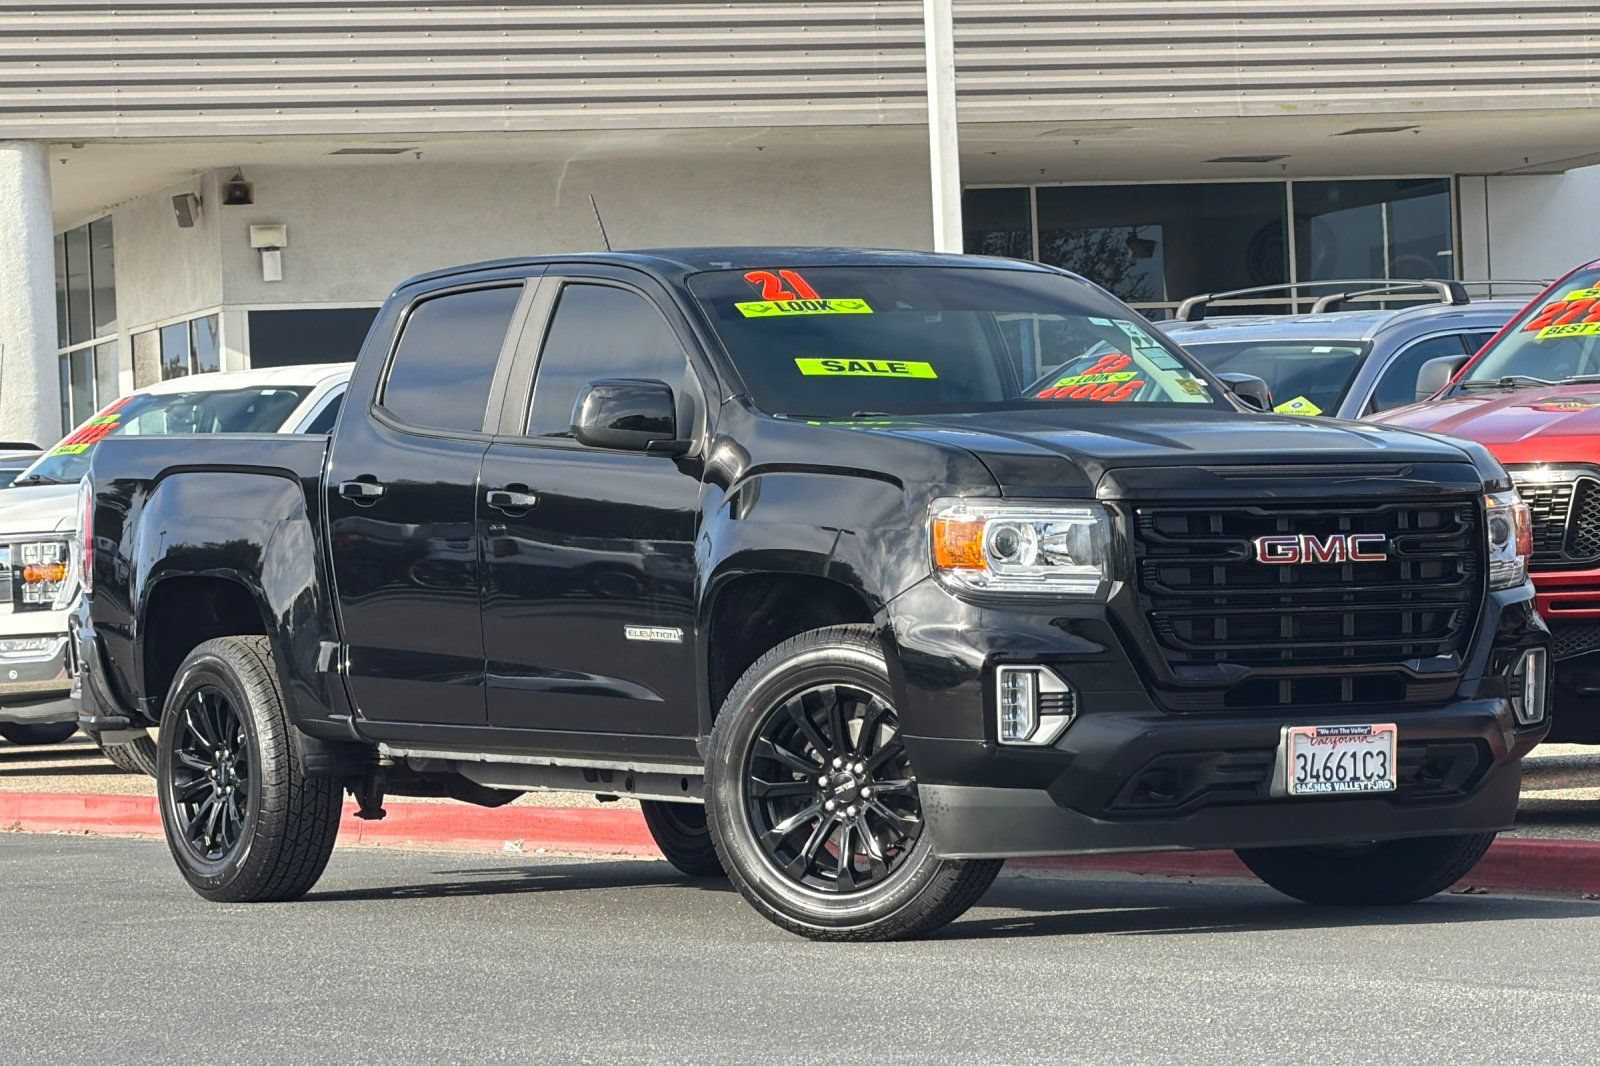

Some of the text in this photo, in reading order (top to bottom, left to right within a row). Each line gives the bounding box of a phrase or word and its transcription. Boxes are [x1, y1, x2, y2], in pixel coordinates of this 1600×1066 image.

[744, 270, 821, 300] 21
[773, 301, 834, 312] LOOK
[1542, 324, 1594, 336] BEST
[820, 360, 909, 374] SALE
[1081, 353, 1132, 375] 23
[1076, 374, 1111, 384] LOOK
[1253, 534, 1387, 564] GMC
[628, 629, 676, 639] ELEVATION
[1296, 750, 1387, 783] 34661C3
[1334, 781, 1365, 791] VALLEY
